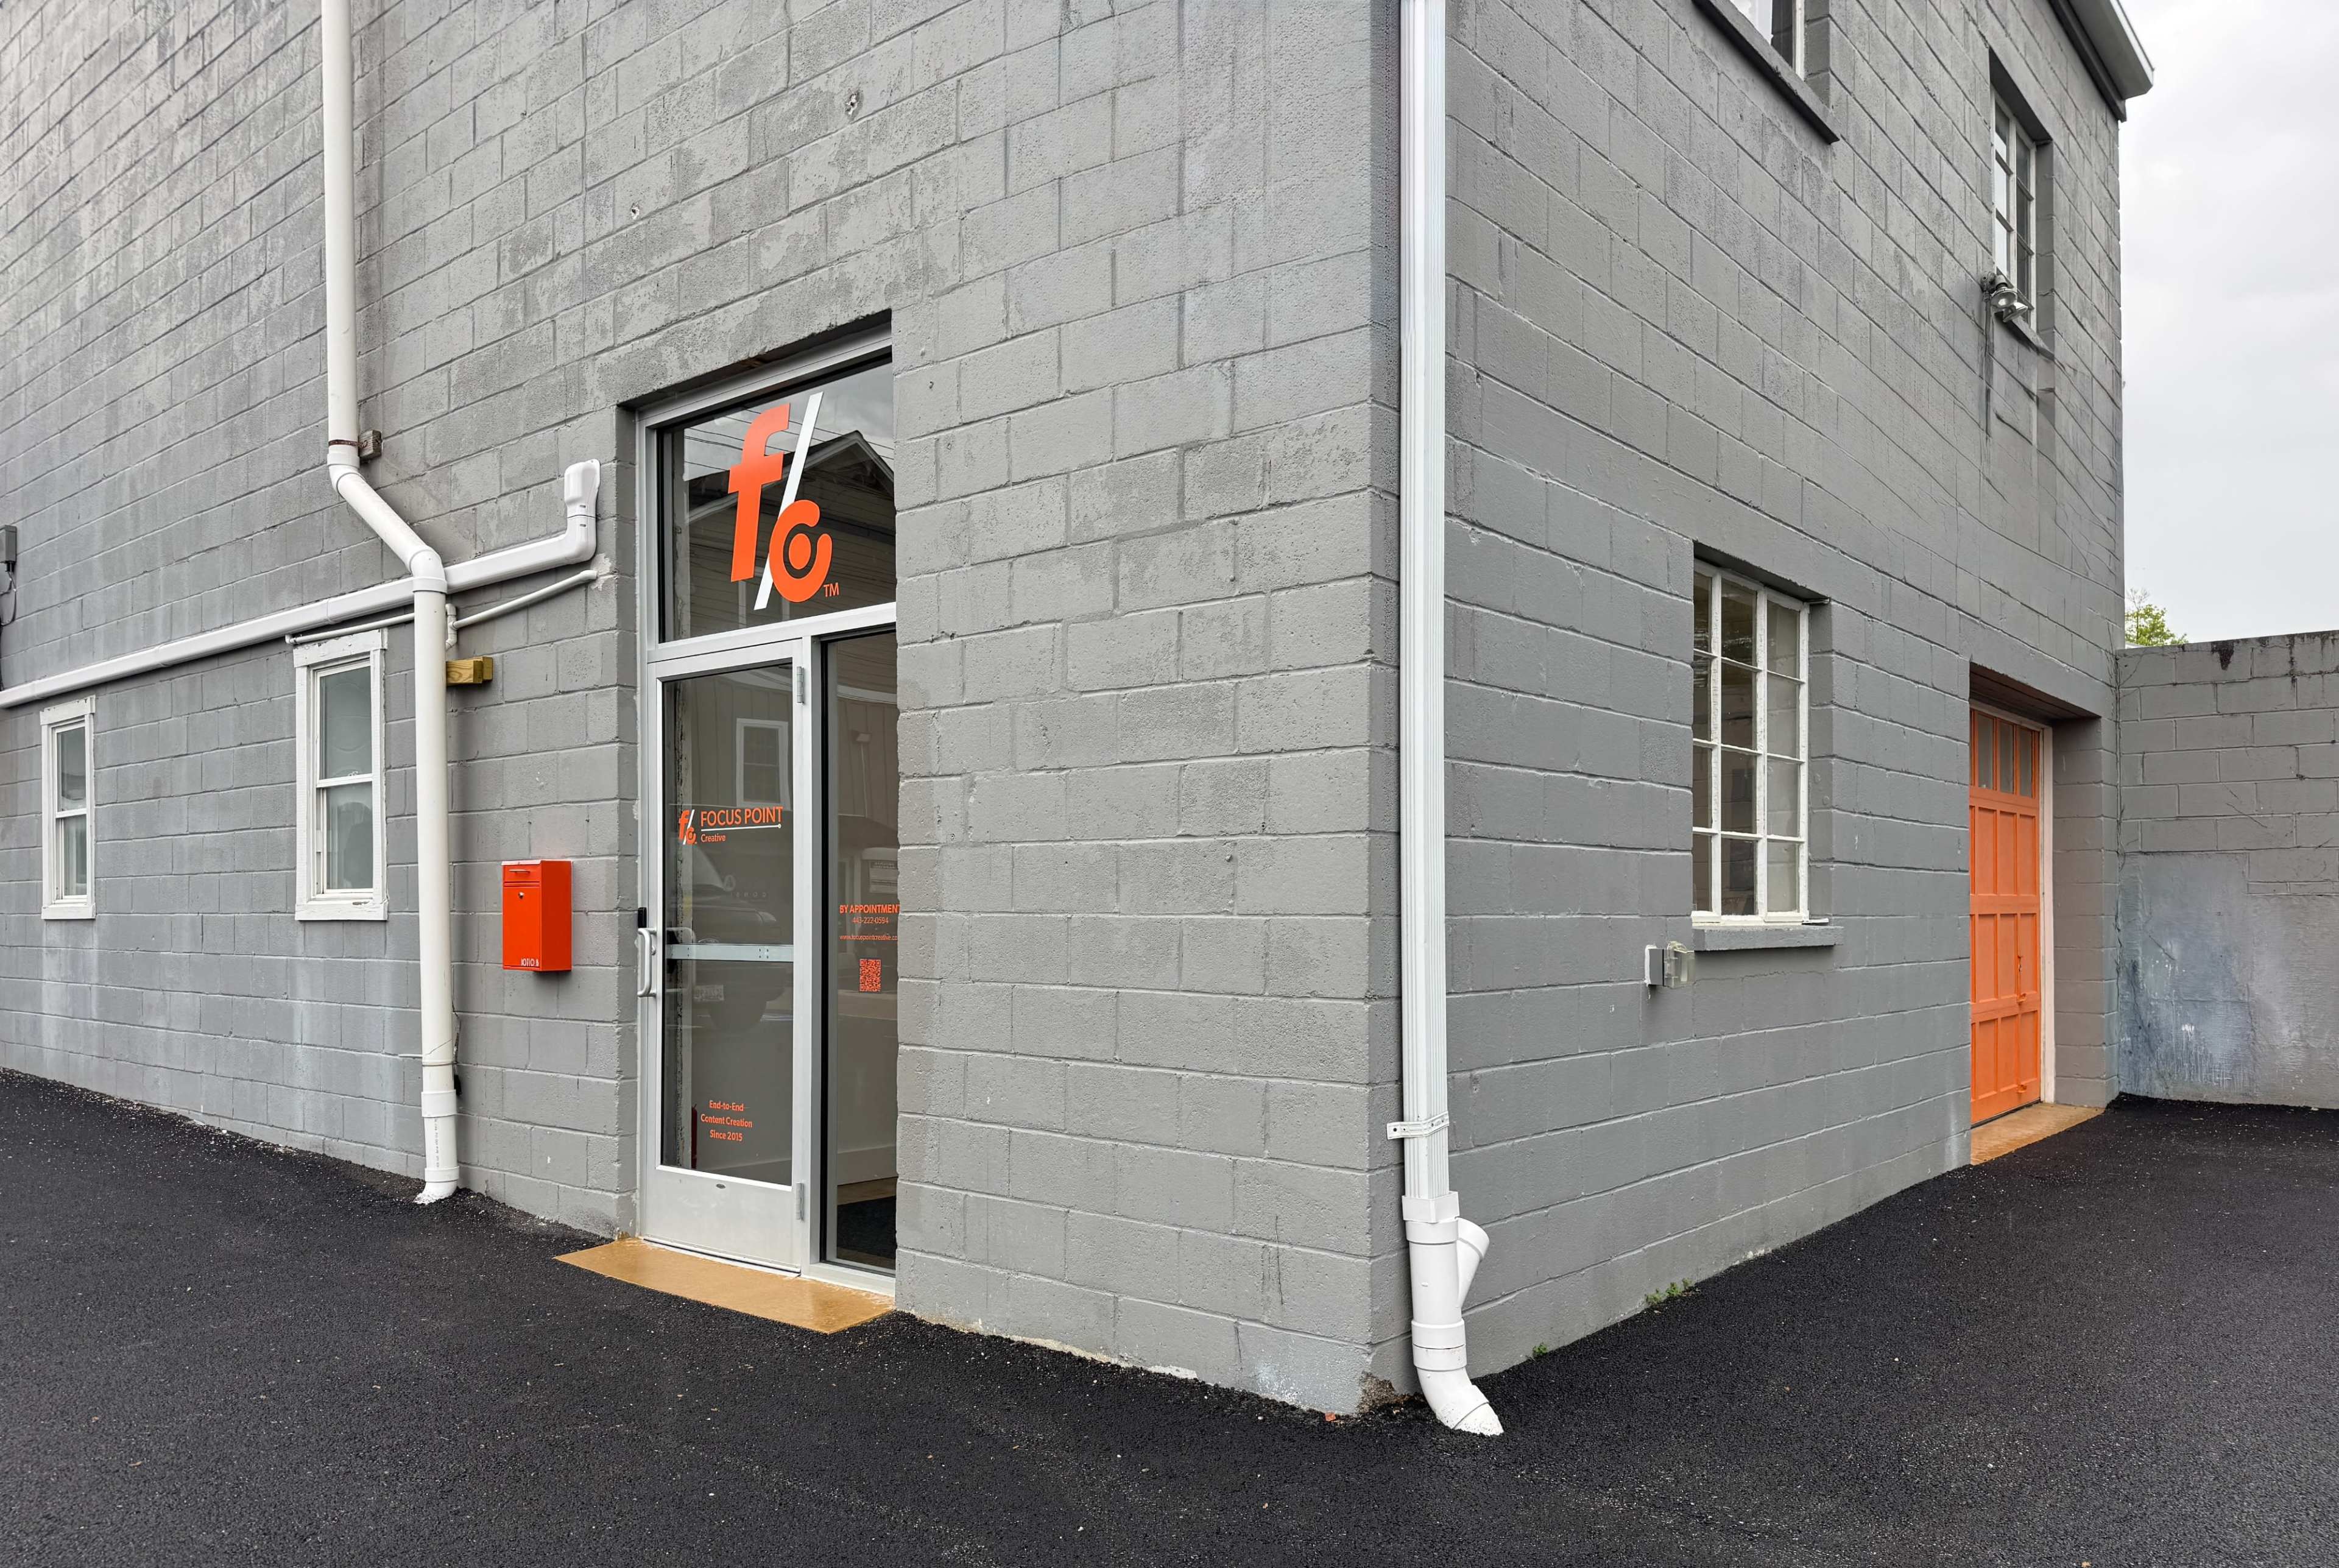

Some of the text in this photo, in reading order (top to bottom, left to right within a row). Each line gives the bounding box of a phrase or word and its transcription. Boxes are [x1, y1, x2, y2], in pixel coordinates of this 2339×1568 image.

[700, 807, 784, 827] FOCUS POINT
[700, 833, 727, 843] Creative
[839, 904, 848, 913] BY
[709, 1100, 744, 1111] End-to-End
[700, 1114, 753, 1128] Content Creation
[710, 1129, 743, 1142] Since 2015
